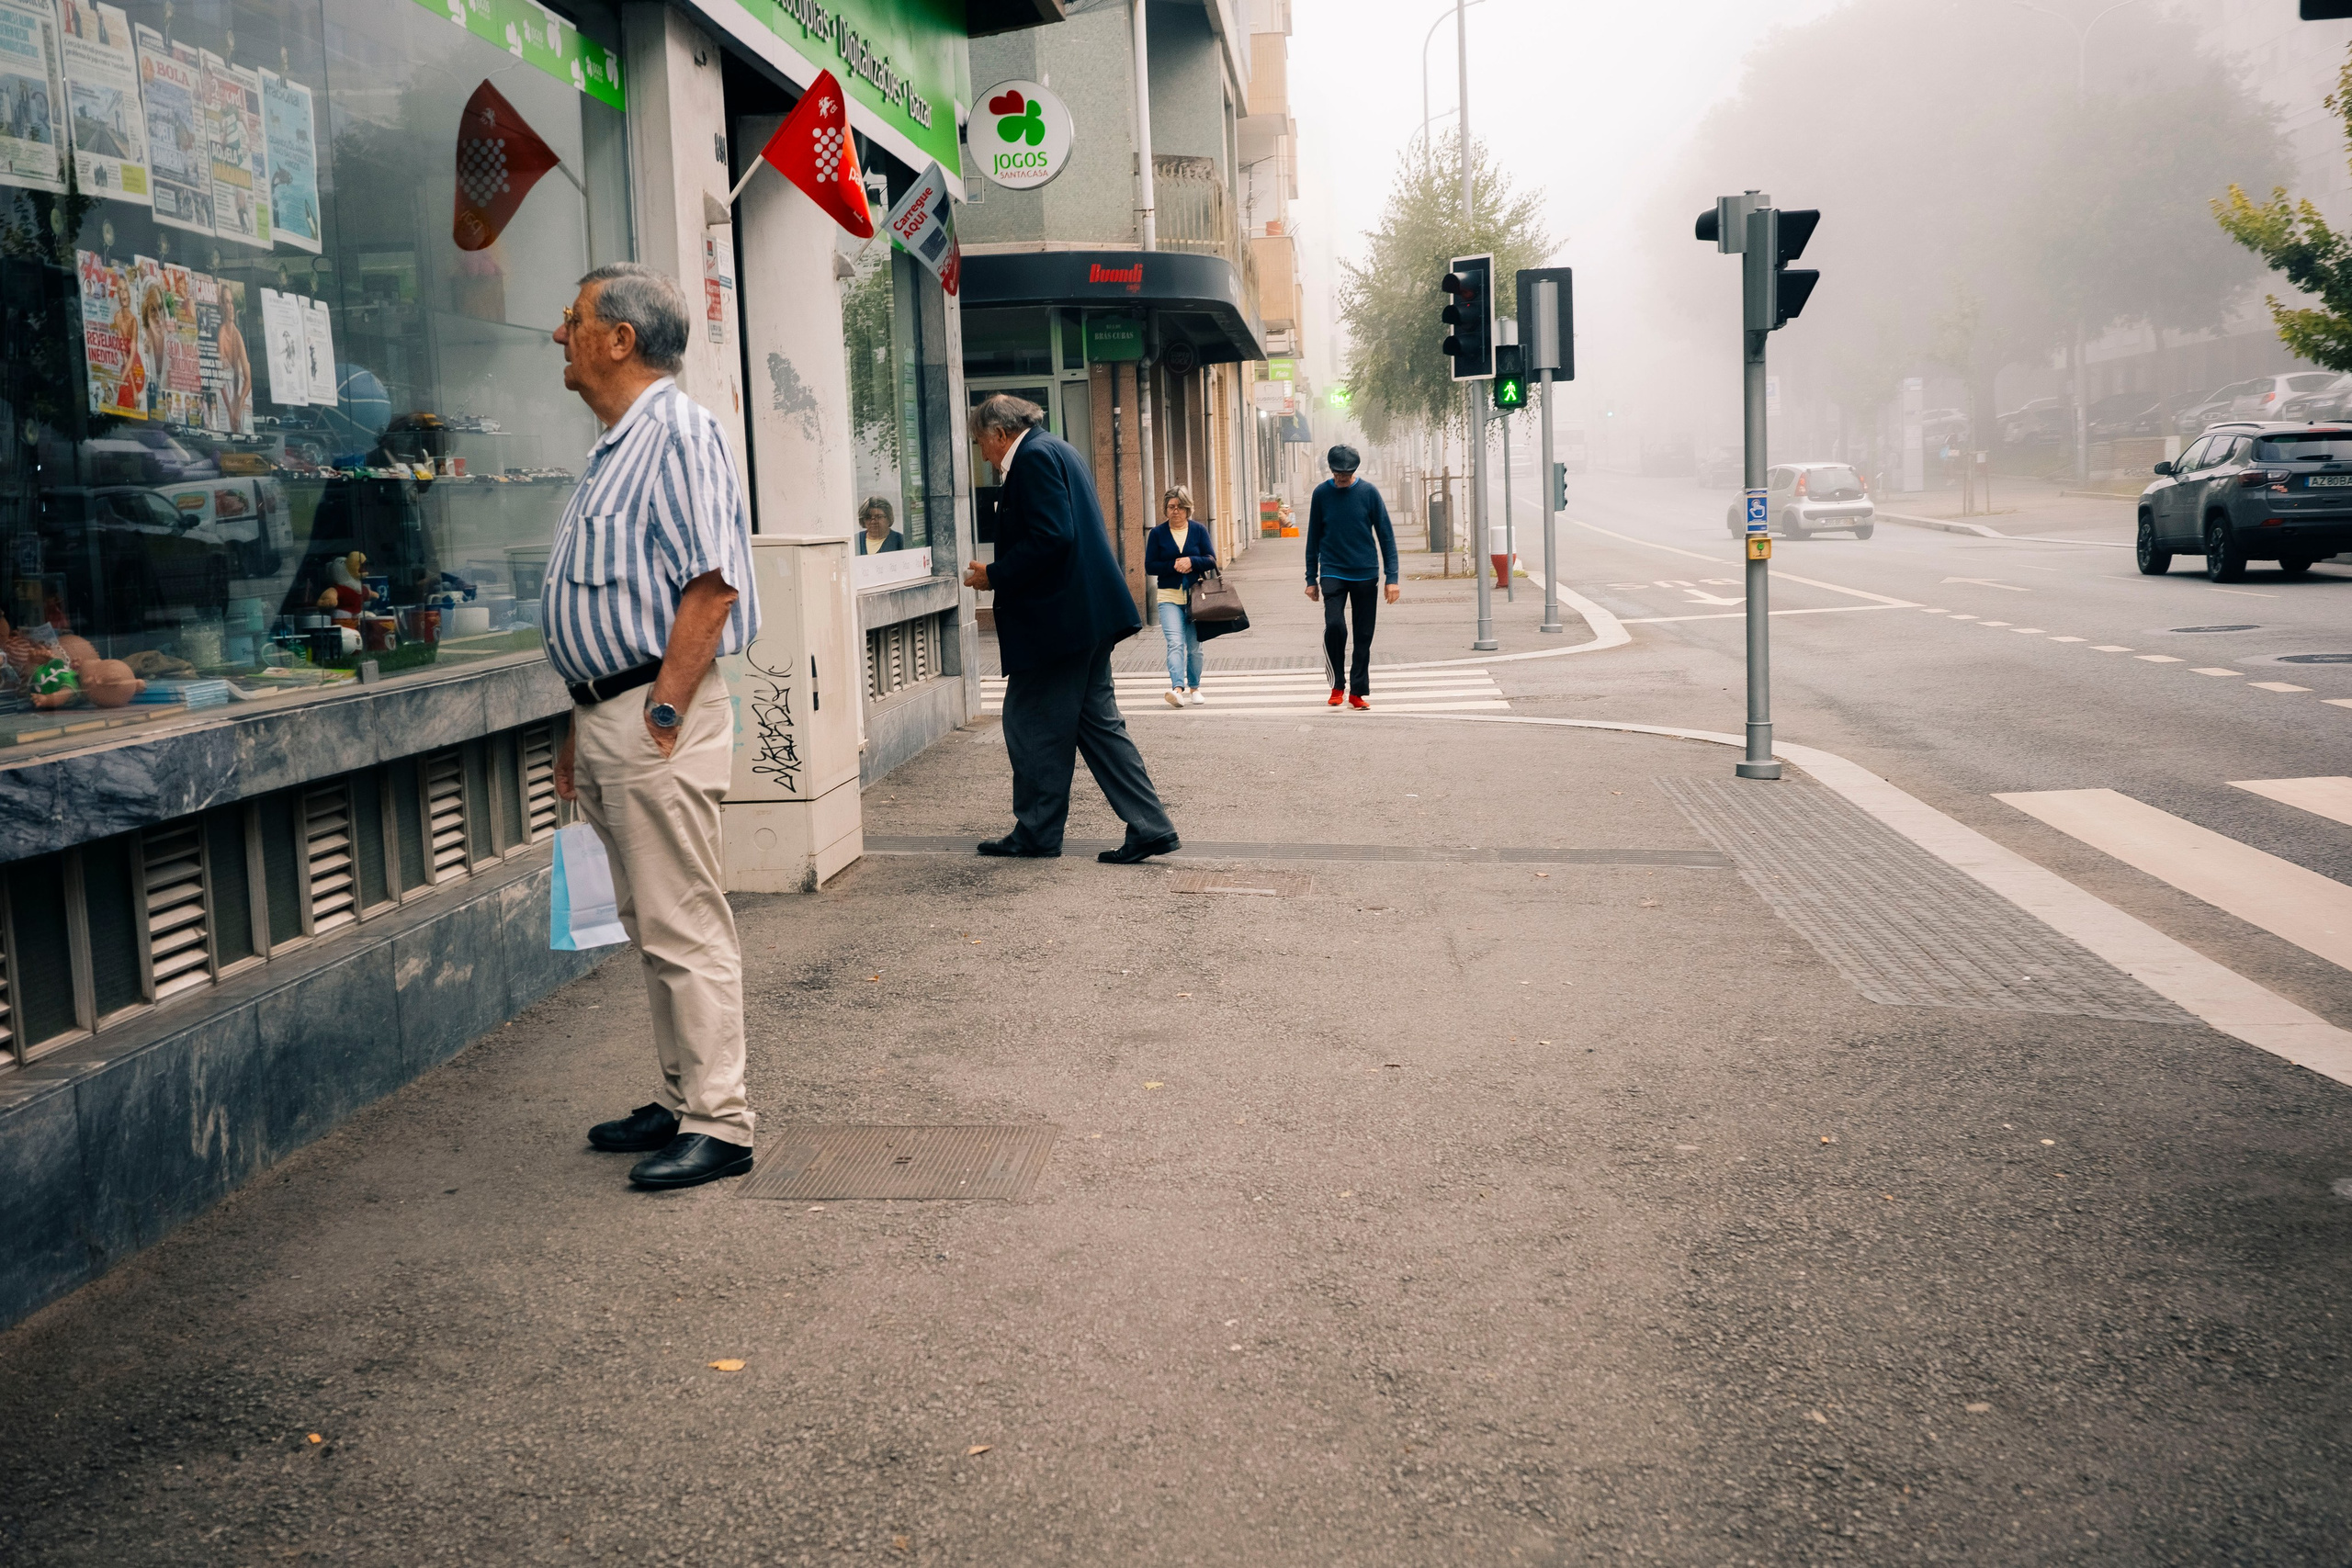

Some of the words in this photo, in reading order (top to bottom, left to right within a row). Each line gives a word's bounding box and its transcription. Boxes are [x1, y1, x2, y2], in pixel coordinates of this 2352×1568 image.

[155, 61, 190, 87] BOLA
[837, 14, 903, 107] Digitalizações
[908, 80, 933, 130] Bazar
[994, 152, 1047, 175] JOGOS
[893, 186, 933, 231] Carregue
[903, 210, 929, 241] AQUI
[1090, 264, 1143, 283] Buondi
[1094, 331, 1112, 340] BRÁS
[1096, 364, 1102, 373] 2
